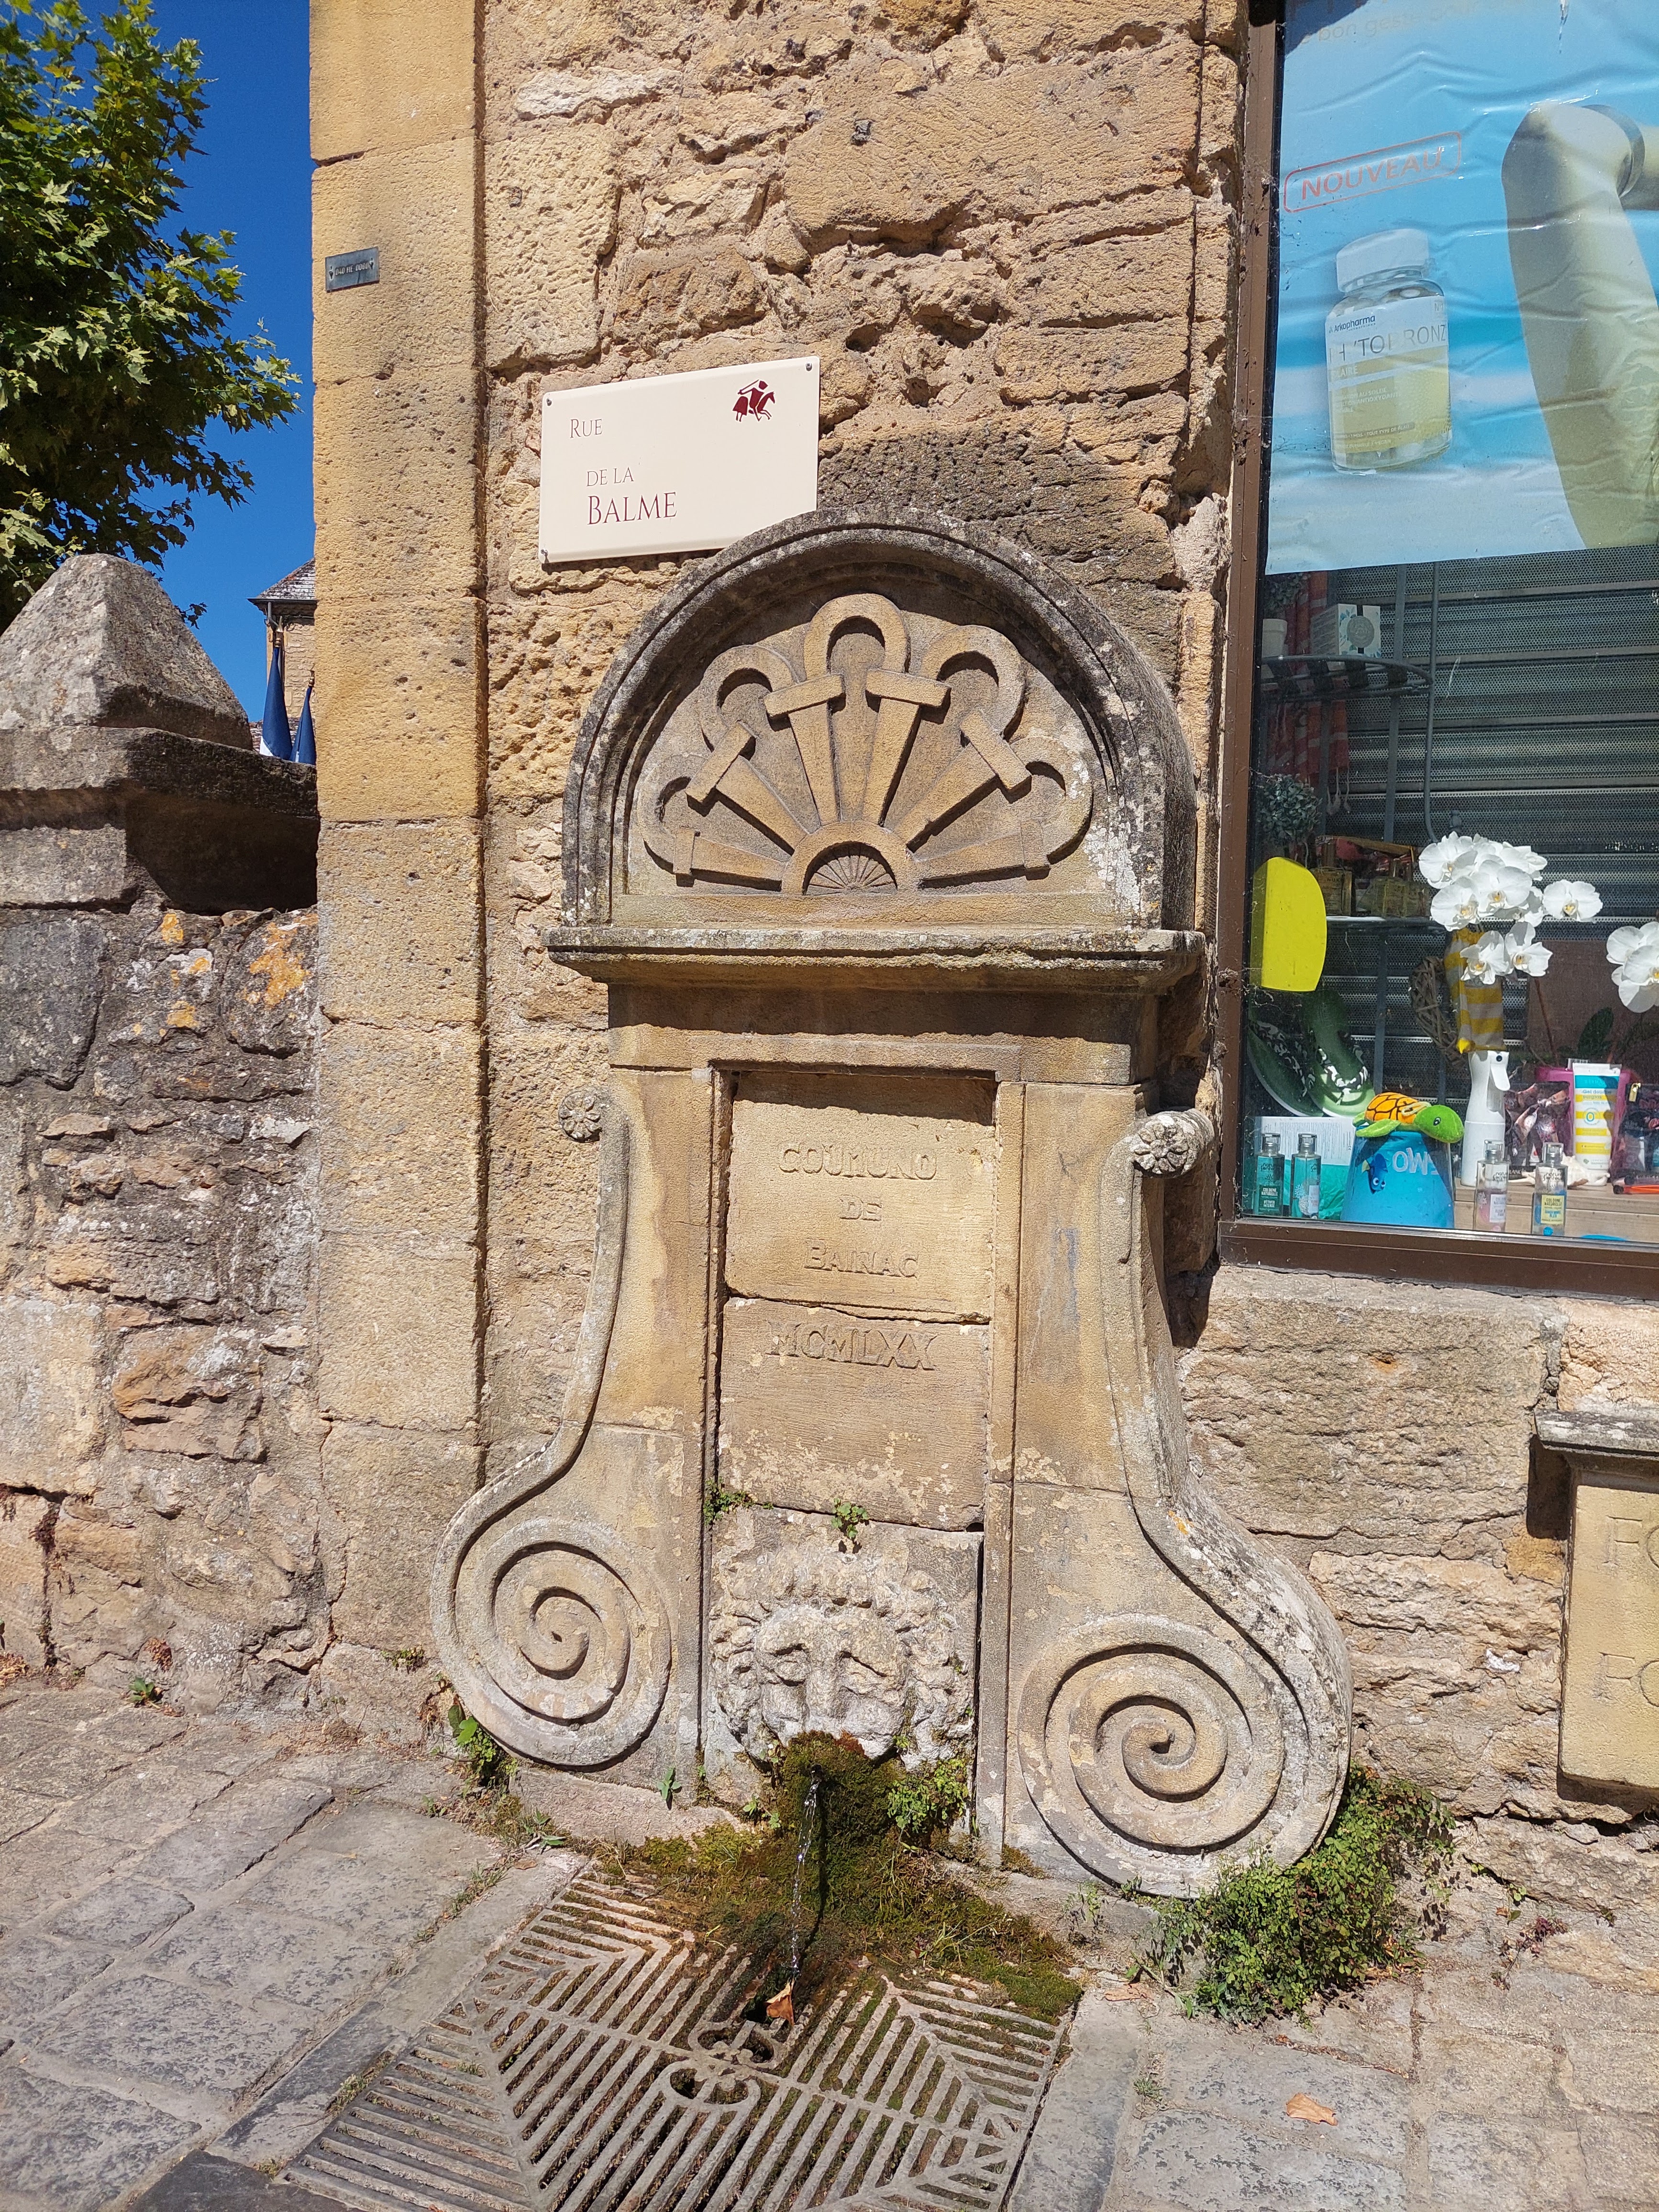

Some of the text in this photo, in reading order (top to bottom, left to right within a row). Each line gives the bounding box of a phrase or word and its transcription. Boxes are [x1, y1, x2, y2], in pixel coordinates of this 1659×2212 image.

[1302, 146, 1442, 200] NOUVEAU
[1334, 315, 1375, 332] Arkopharma
[570, 419, 603, 438] RUE
[586, 466, 634, 487] DE LA
[587, 491, 677, 525] BALME
[840, 1194, 883, 1222] DE
